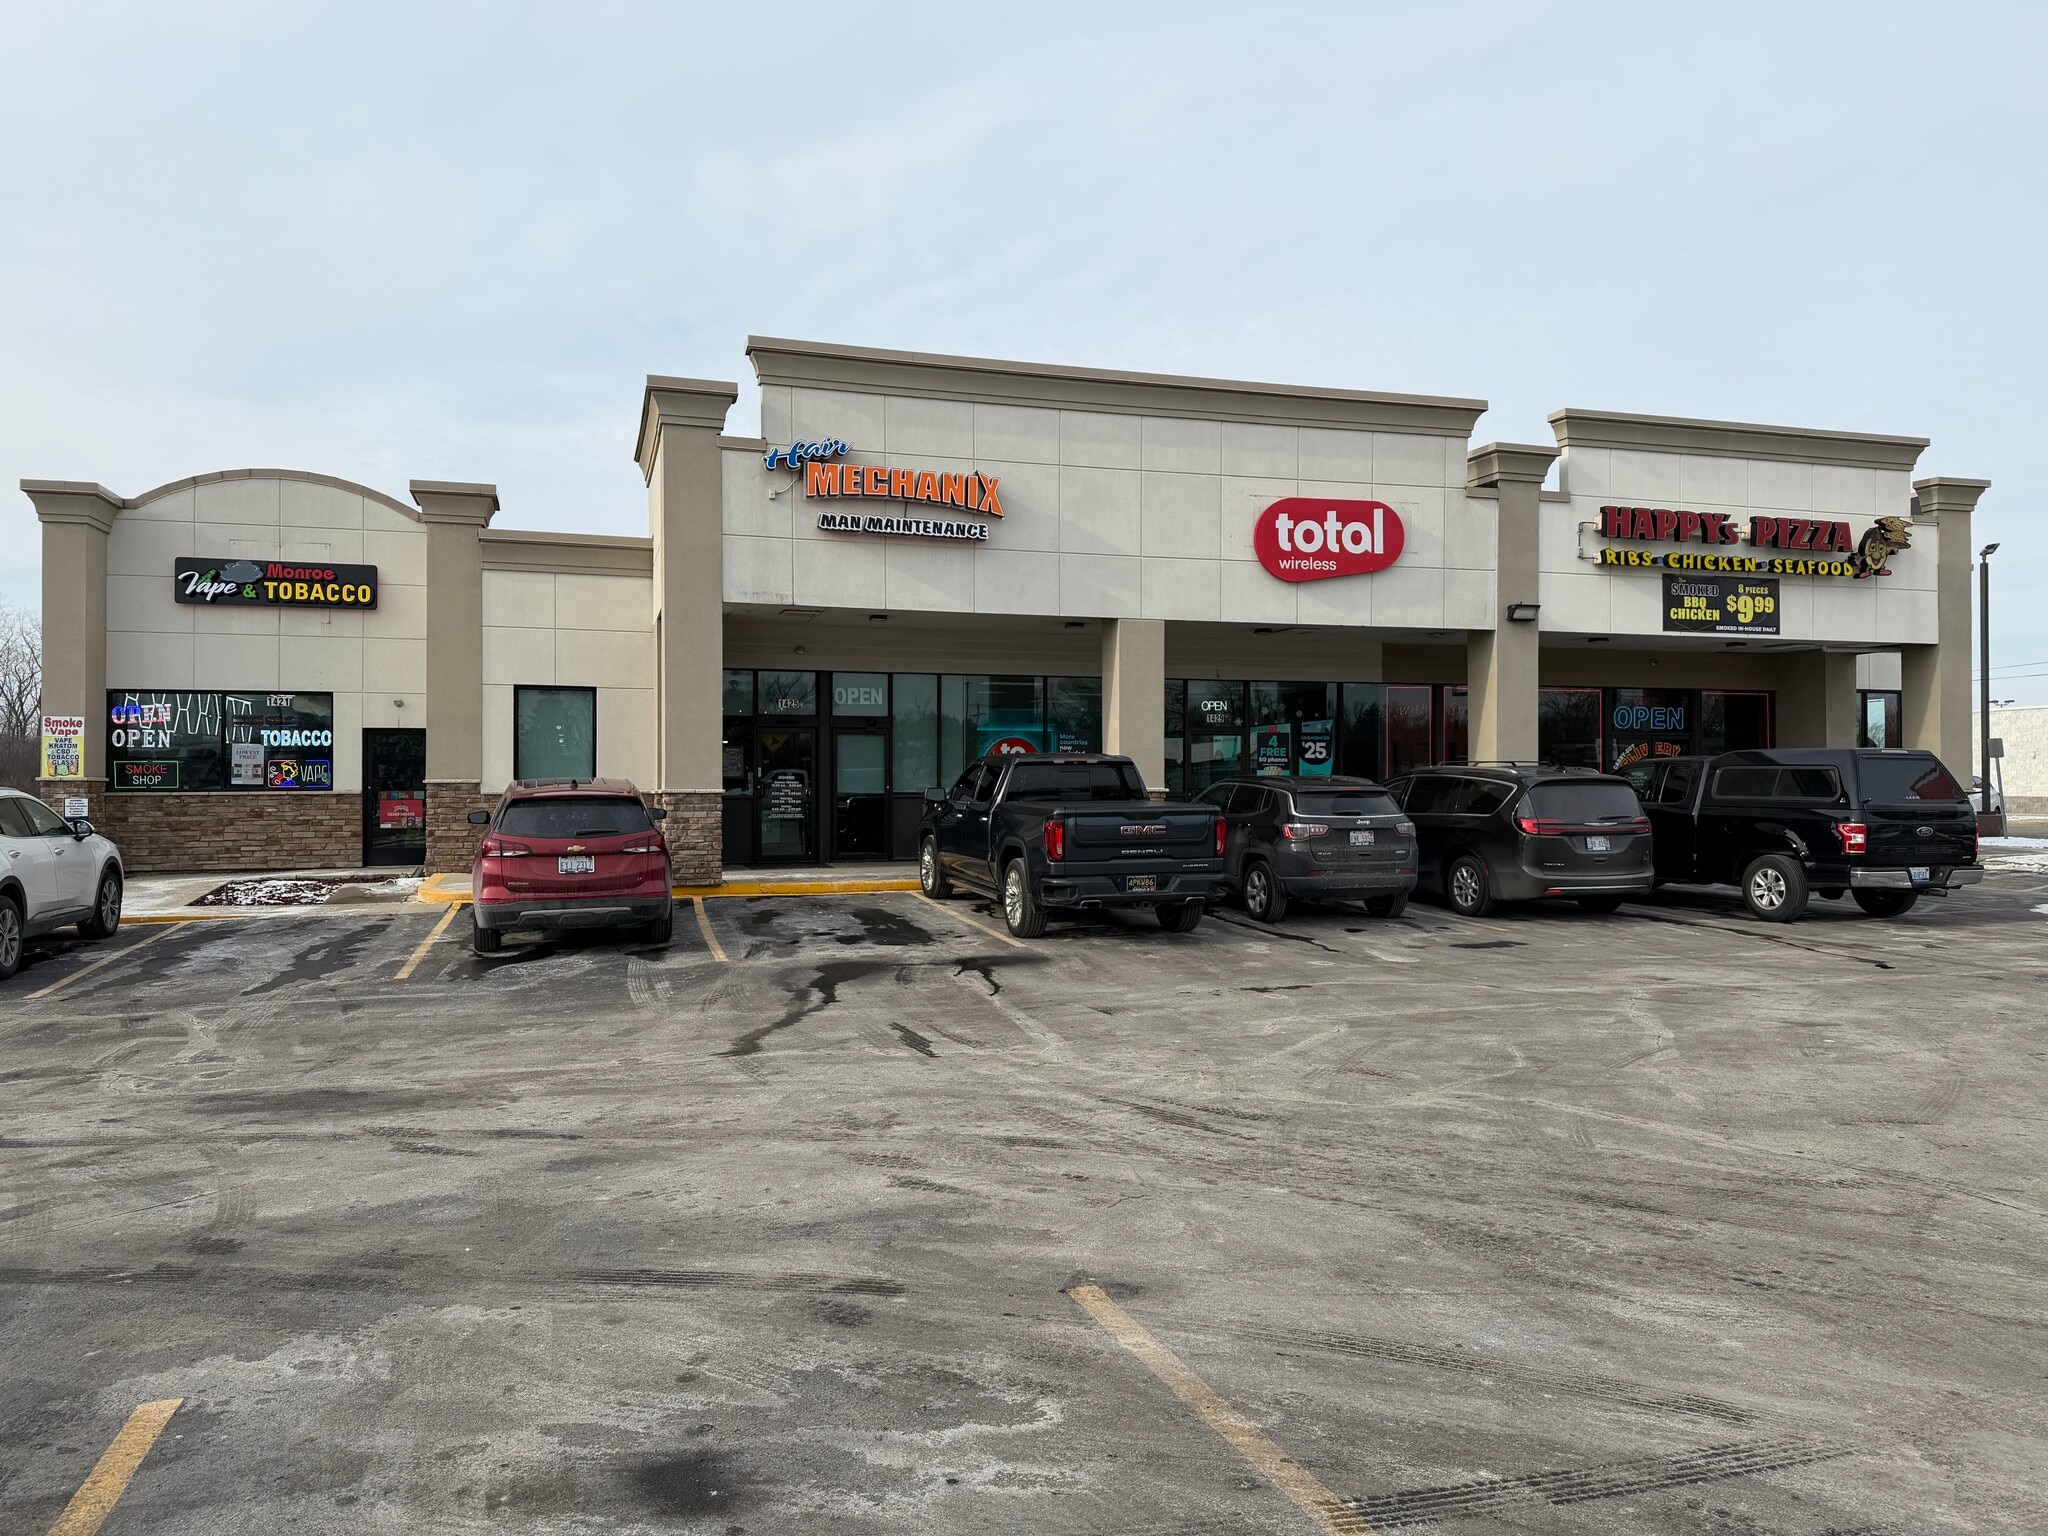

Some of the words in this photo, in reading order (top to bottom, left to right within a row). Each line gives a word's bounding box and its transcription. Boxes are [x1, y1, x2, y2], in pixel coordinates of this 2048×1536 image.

[765, 437, 854, 471] Hair
[806, 462, 1005, 518] MECHANIX
[819, 512, 862, 530] MAN
[863, 513, 988, 538] MAINTENANCE
[1276, 508, 1383, 554] total
[1752, 516, 1852, 552] PIZZA
[1279, 556, 1337, 570] wireless
[1604, 548, 1652, 566] RIBS
[1667, 553, 1756, 572] CHICKEN
[1772, 559, 1854, 576] SEAFOOD
[266, 563, 335, 580] Monroe
[178, 571, 238, 601] Vape
[243, 584, 257, 598] &
[264, 582, 372, 603] TOBACCO
[1671, 583, 1719, 597] SMOKED
[1738, 584, 1744, 593] 8
[1684, 597, 1707, 609] BBQ
[1670, 608, 1720, 621] CHICKEN
[268, 697, 290, 706] 1421
[834, 687, 883, 704] OPEN
[779, 699, 799, 708] 1425
[1201, 700, 1228, 711] OPEN
[112, 704, 171, 724] OPEN
[1207, 714, 1224, 722] 1429
[1614, 706, 1684, 729] OPEN
[44, 717, 83, 727] Smoke
[50, 727, 79, 737] Vape
[112, 729, 170, 747] OPEN
[261, 730, 332, 747] TOBACCO
[1268, 735, 1278, 747] 4
[1260, 748, 1287, 757] FREE
[125, 764, 167, 774] SMOKE
[300, 765, 327, 782] VAPE
[132, 775, 162, 785] SHOP
[1121, 825, 1166, 835] GMC
